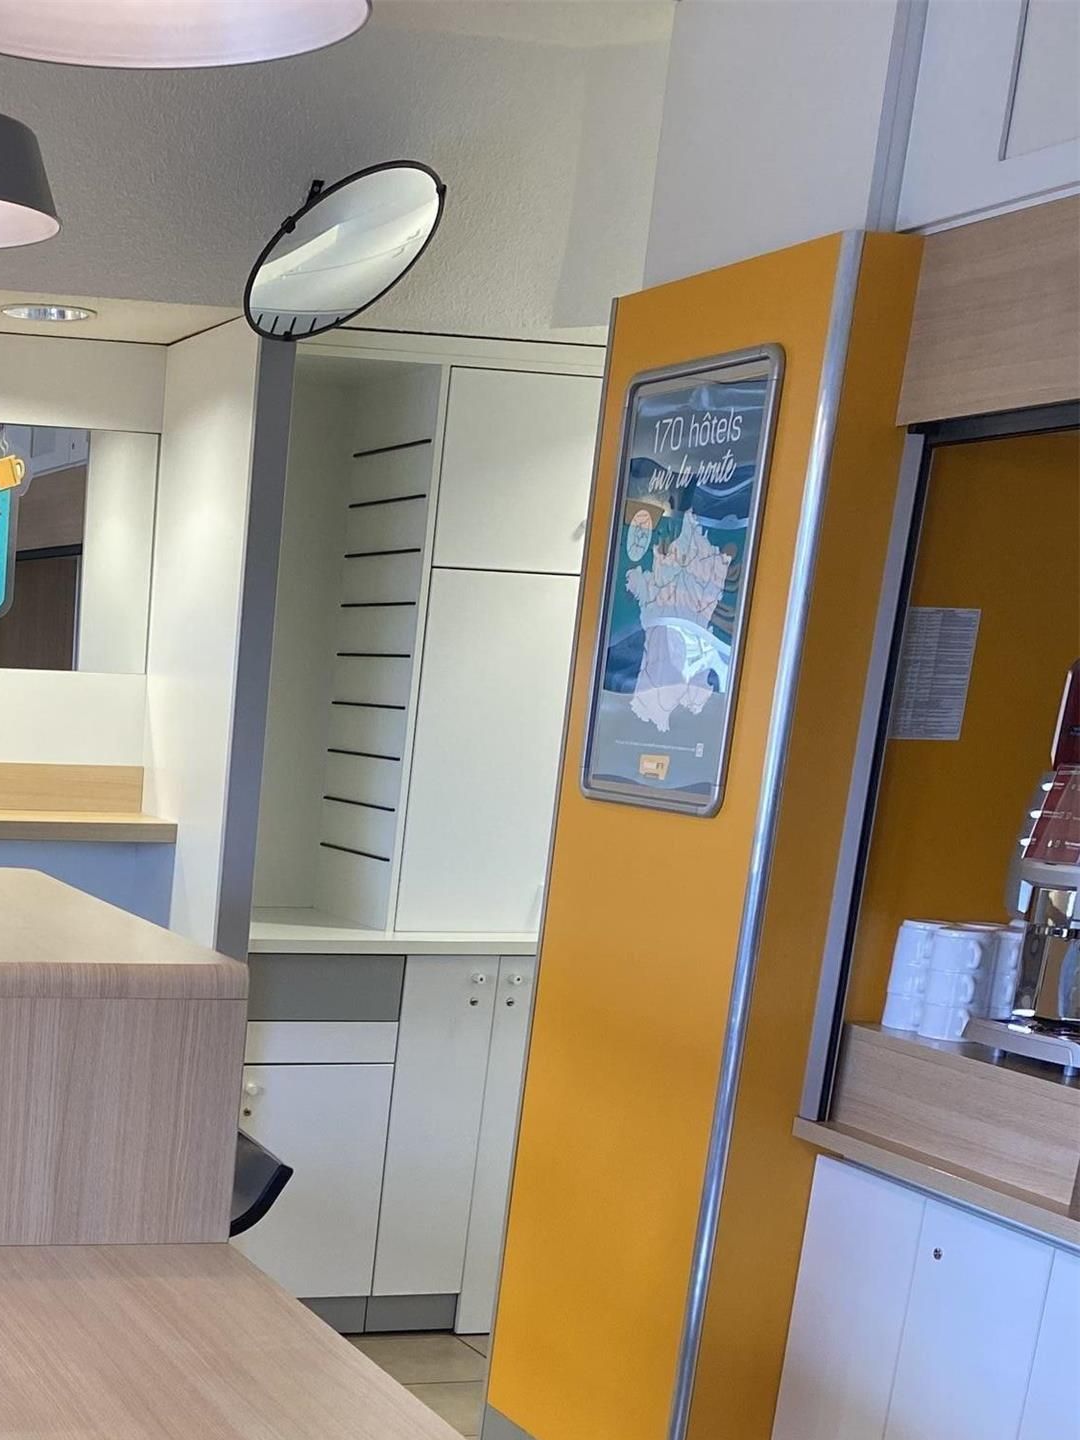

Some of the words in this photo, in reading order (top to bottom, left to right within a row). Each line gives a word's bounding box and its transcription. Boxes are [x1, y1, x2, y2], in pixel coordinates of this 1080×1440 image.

[653, 416, 684, 454] 170
[687, 407, 743, 449] hôtels
[648, 465, 675, 493] sur
[675, 454, 695, 489] la
[696, 449, 737, 487] route
